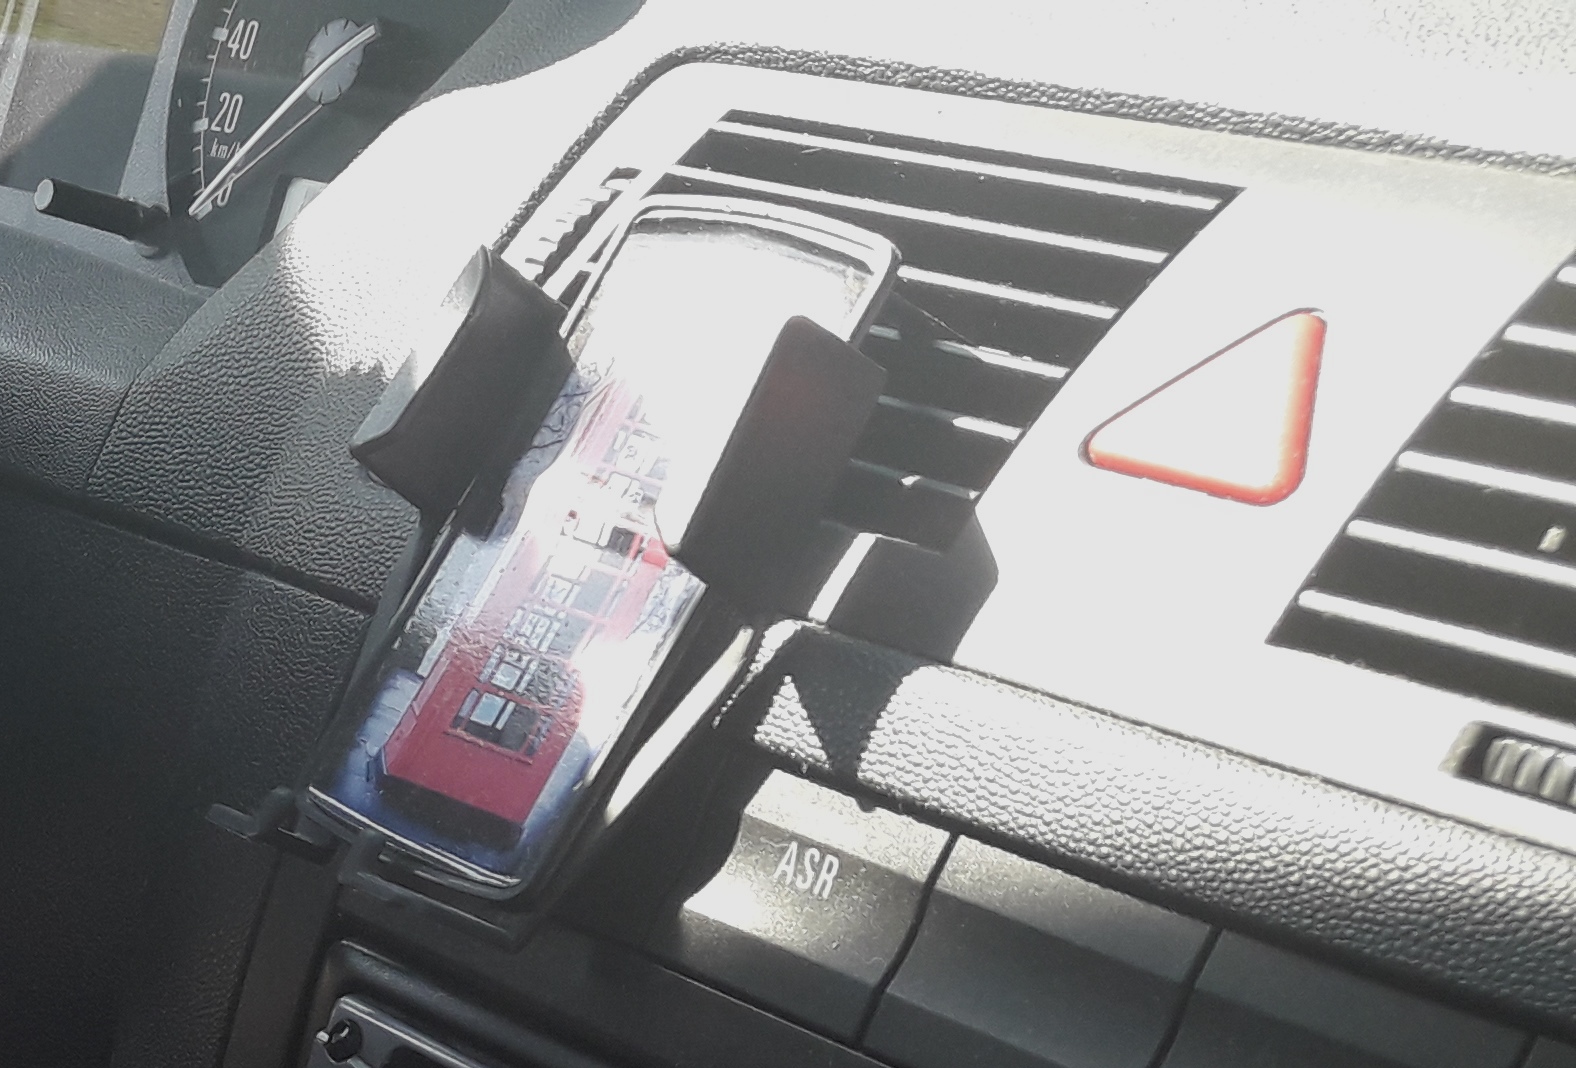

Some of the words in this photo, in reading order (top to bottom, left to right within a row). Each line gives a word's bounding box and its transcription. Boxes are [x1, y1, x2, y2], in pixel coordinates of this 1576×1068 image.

[227, 18, 260, 60] 40
[210, 92, 243, 134] 20
[772, 841, 840, 899] ASR
